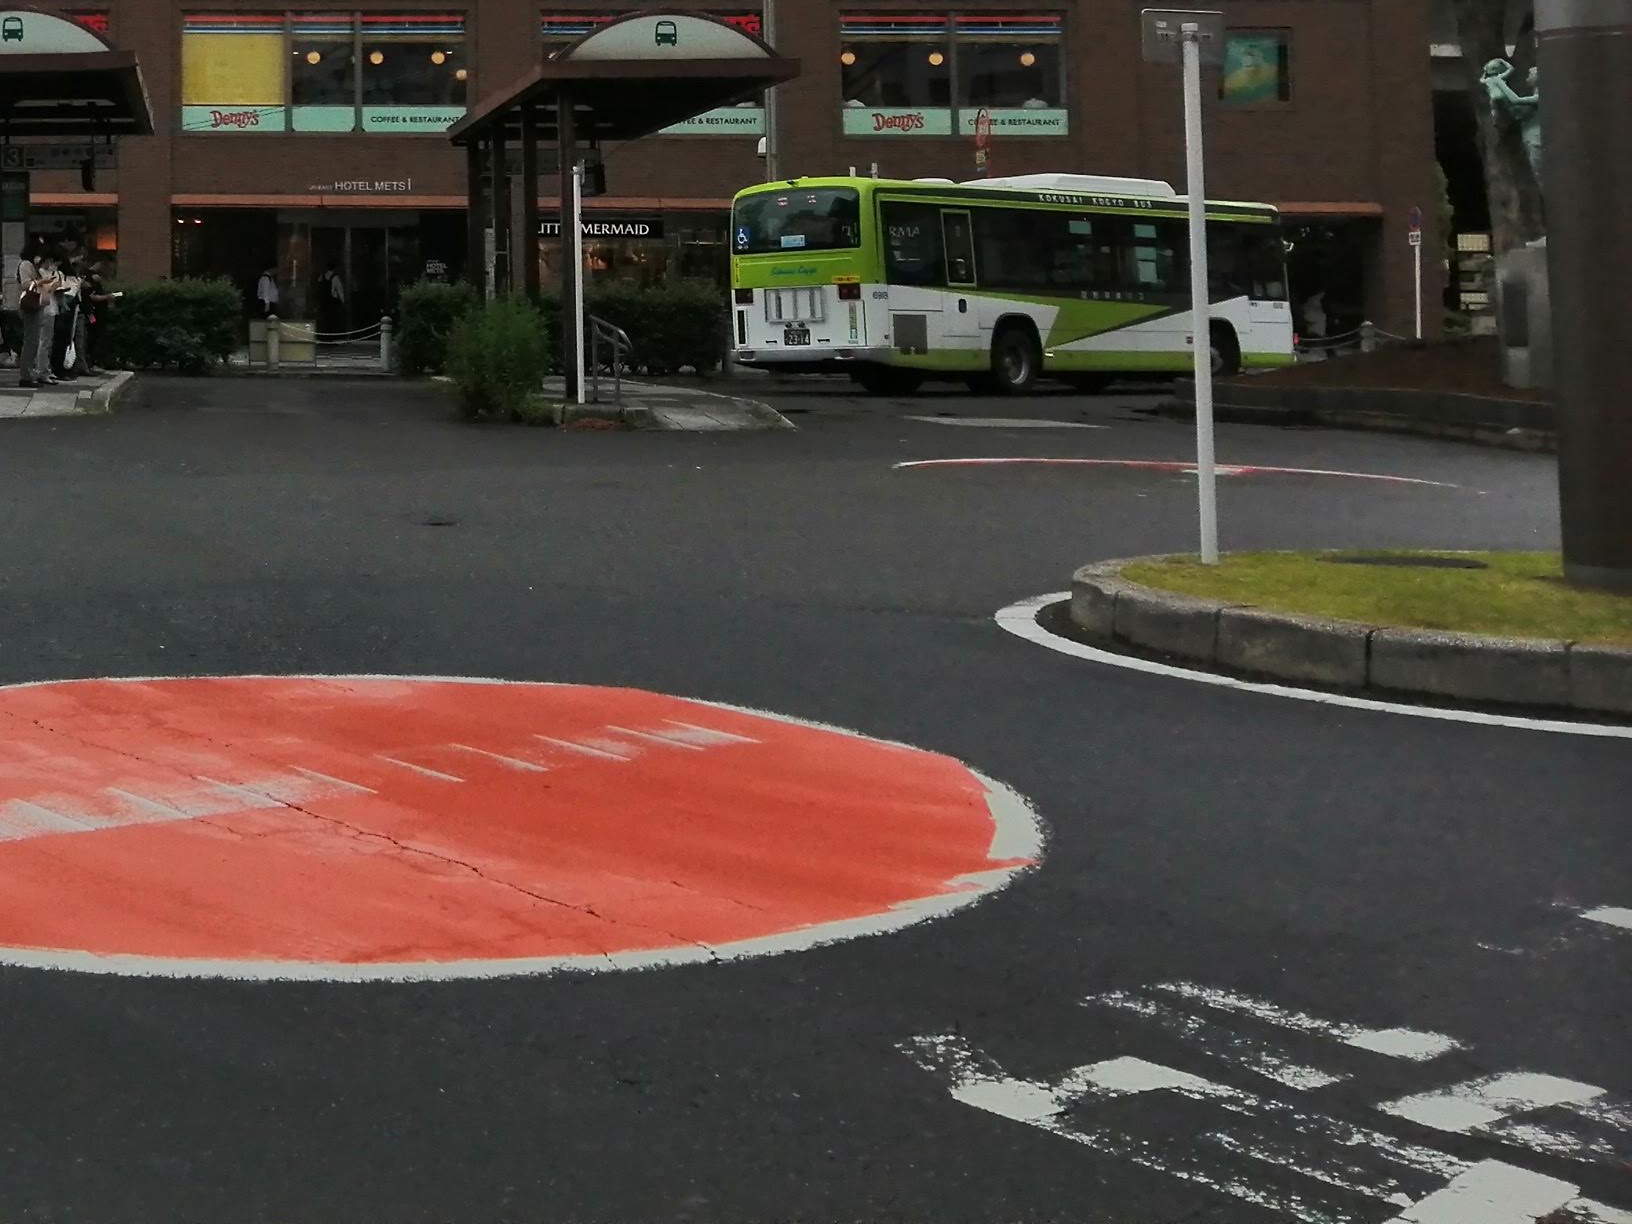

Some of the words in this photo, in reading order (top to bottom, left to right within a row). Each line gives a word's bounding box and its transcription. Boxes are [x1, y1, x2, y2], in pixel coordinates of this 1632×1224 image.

[211, 109, 260, 129] Denny's
[872, 112, 925, 131] Denny's
[1008, 118, 1060, 126] RESTAURANT
[7, 147, 19, 166] 3
[335, 181, 372, 191] HOTEL
[375, 181, 406, 191] METS
[581, 223, 650, 236] MERMAID
